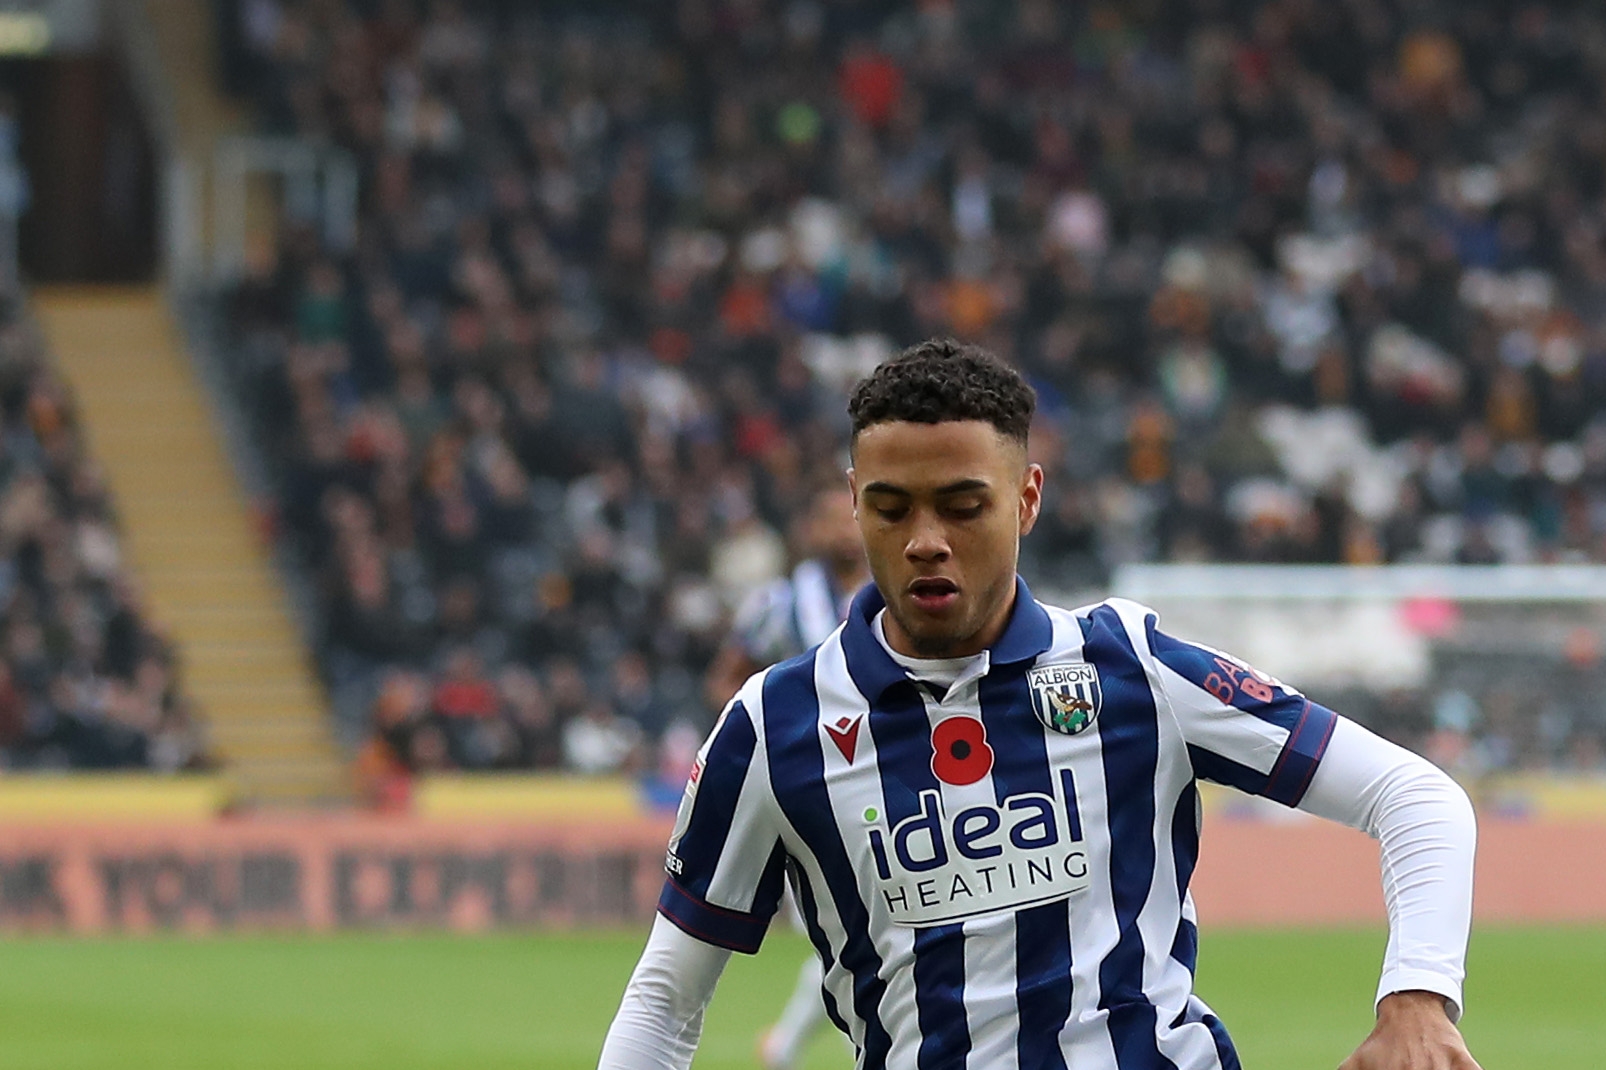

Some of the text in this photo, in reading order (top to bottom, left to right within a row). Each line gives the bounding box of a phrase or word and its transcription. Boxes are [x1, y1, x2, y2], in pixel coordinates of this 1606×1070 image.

[1034, 670, 1093, 686] ALBION
[864, 768, 1083, 880] ideal
[883, 852, 1088, 913] HEATING
